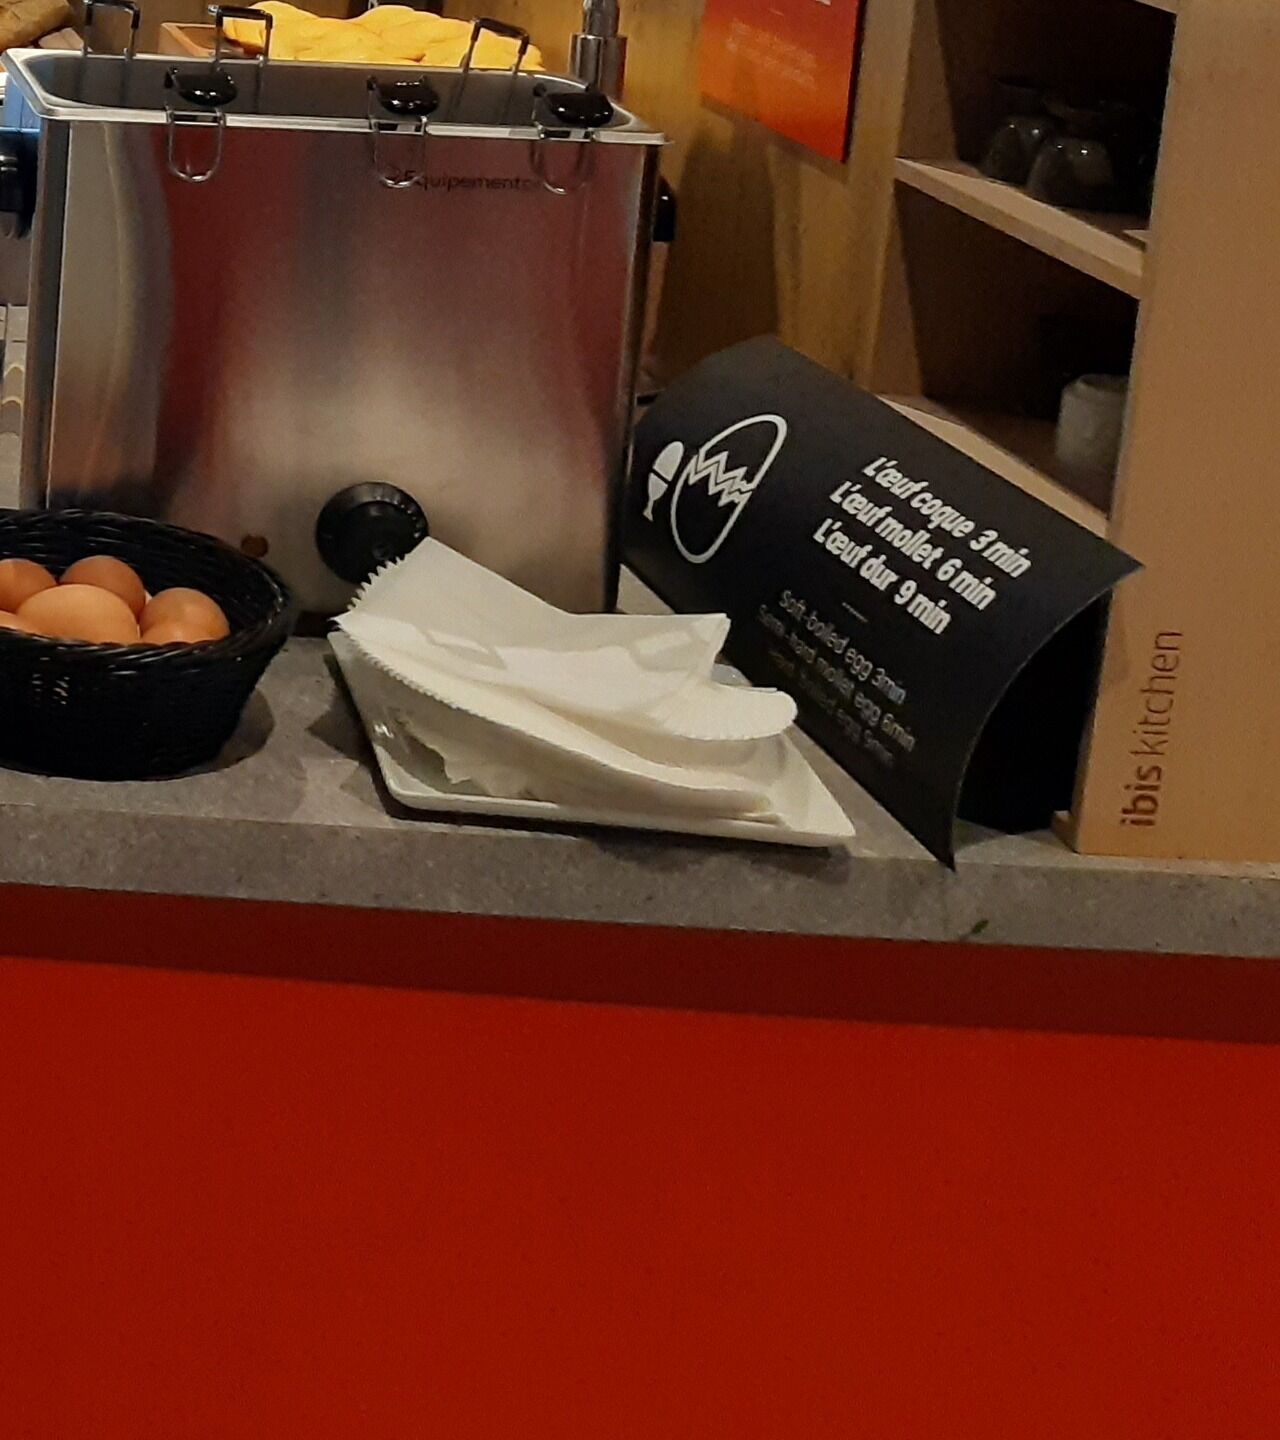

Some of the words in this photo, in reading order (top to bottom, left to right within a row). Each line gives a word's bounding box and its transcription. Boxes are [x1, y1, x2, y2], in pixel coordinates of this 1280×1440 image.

[909, 491, 976, 538] coque
[874, 515, 945, 571] mollet
[969, 529, 999, 552] 3
[981, 540, 1032, 578] min
[859, 553, 900, 592] dur
[936, 558, 963, 582] 6
[893, 579, 918, 606] 9
[948, 570, 997, 611] min
[905, 592, 952, 636] min
[844, 647, 873, 681] egg
[1129, 631, 1184, 756] kitchen
[1120, 765, 1162, 827] ibis
